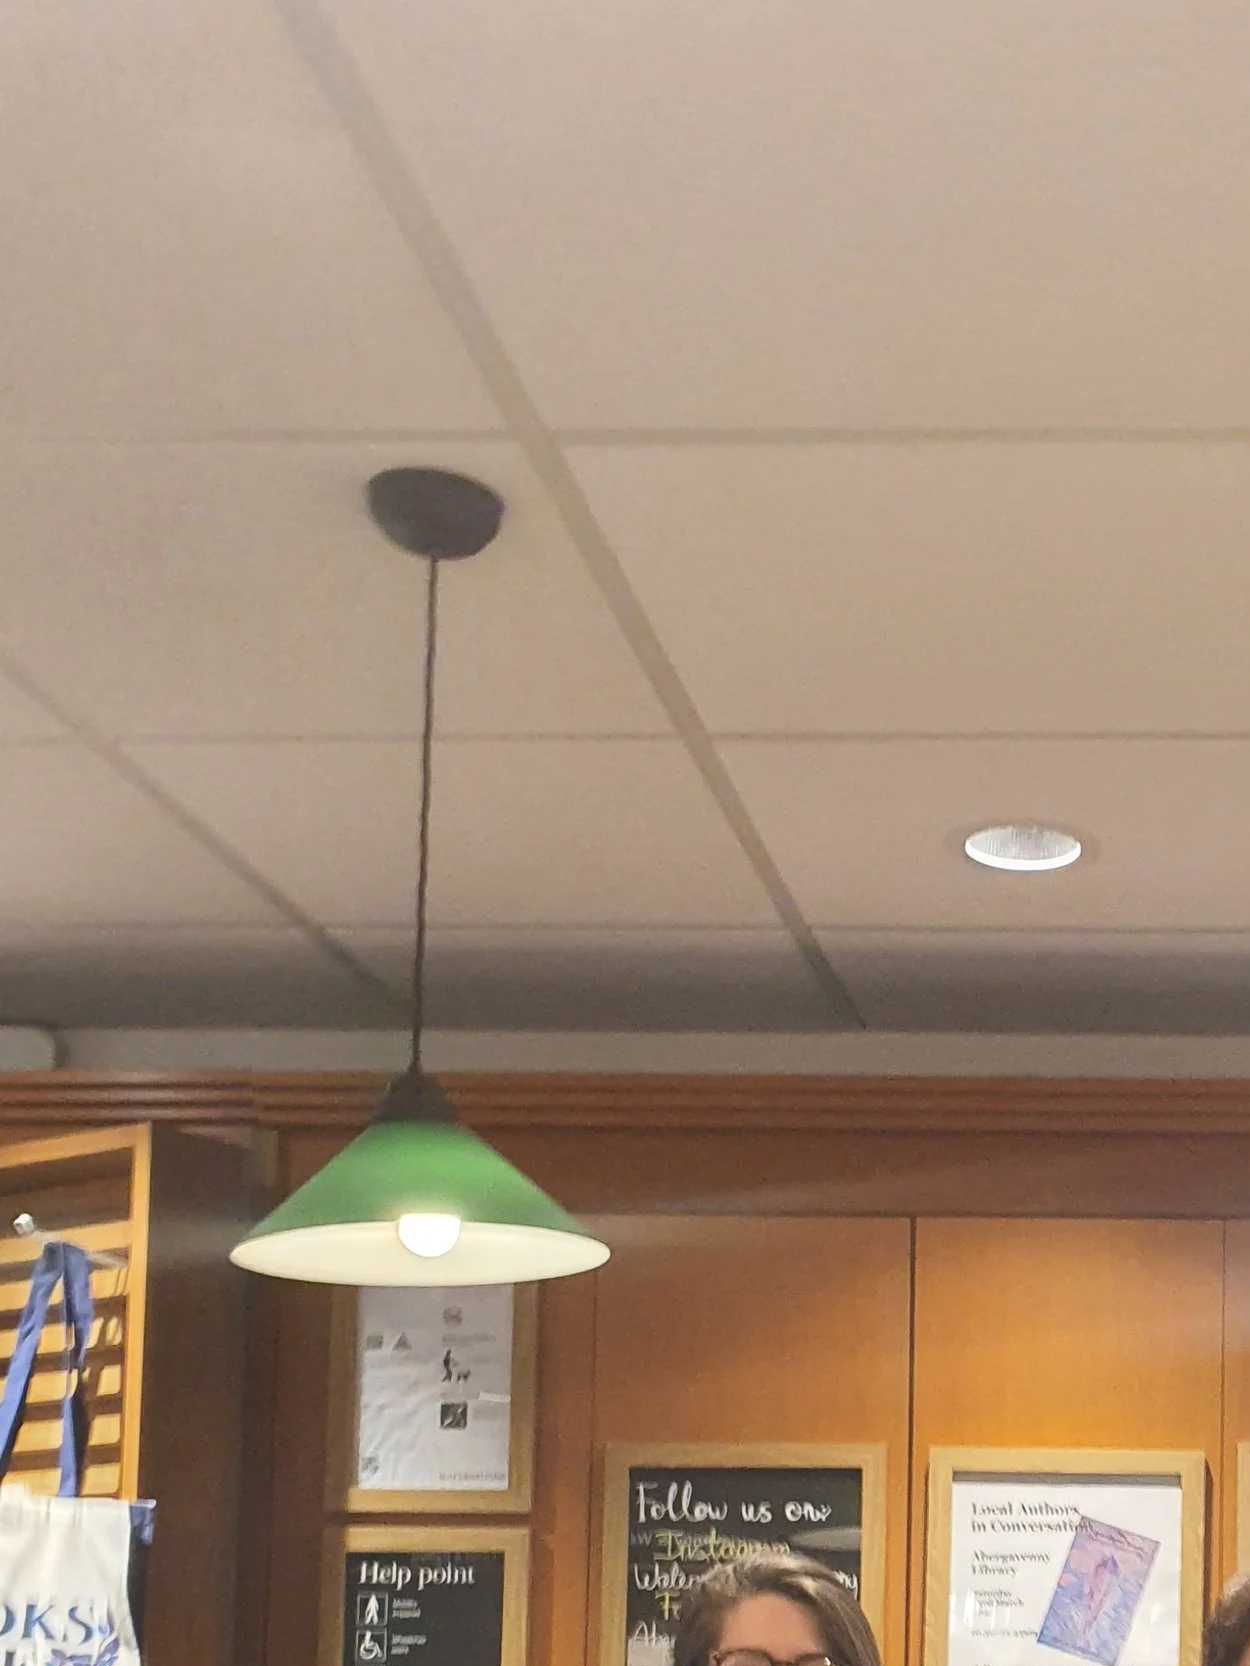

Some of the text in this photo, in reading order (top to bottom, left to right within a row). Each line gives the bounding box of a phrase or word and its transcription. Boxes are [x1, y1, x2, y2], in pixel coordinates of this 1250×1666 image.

[637, 1480, 727, 1523] Follow
[741, 1502, 773, 1523] us
[971, 1501, 1081, 1516] Local Authors
[990, 1519, 1093, 1533] Conversation
[358, 1560, 477, 1591] Help point
[971, 1564, 1018, 1577] Library
